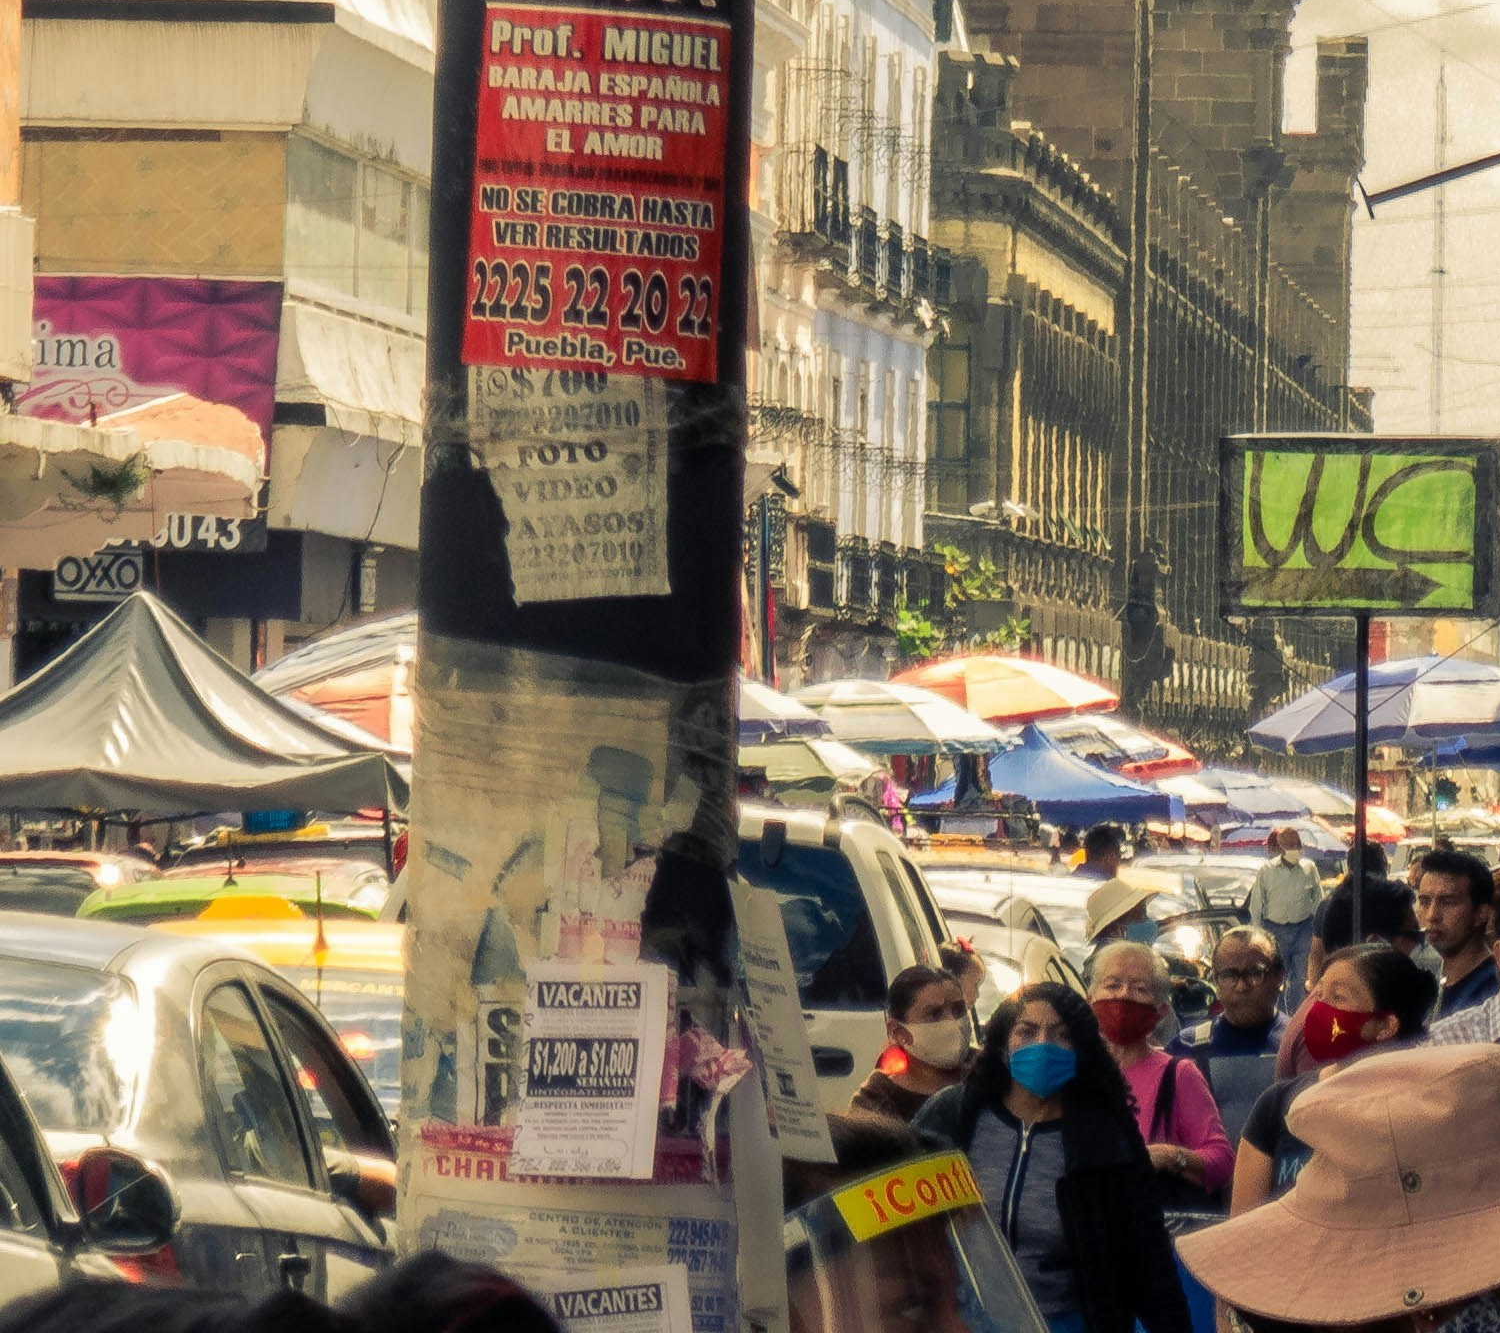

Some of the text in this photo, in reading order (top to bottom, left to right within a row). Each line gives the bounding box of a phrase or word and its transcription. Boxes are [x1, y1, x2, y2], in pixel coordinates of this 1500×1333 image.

[490, 20, 721, 72] Prof. MIGUEL
[488, 66, 721, 108] BARAJA ESPAÑOLA
[501, 94, 706, 135] AMARRES PARA
[546, 129, 663, 162] EL AMOR
[480, 185, 714, 230] NO SE COBRA HASTA
[492, 219, 700, 261] VER RESULTADOS
[471, 256, 713, 339] 2225 22 20 22
[504, 331, 687, 372] Puebla, Pue.
[518, 439, 608, 469] FOTO
[1249, 450, 1475, 569] WC
[56, 556, 140, 591] OXXO
[541, 983, 638, 1008] VACANTES
[532, 1041, 577, 1082] $1,200
[578, 1050, 588, 1077] a
[558, 1284, 659, 1319] VACANTES
